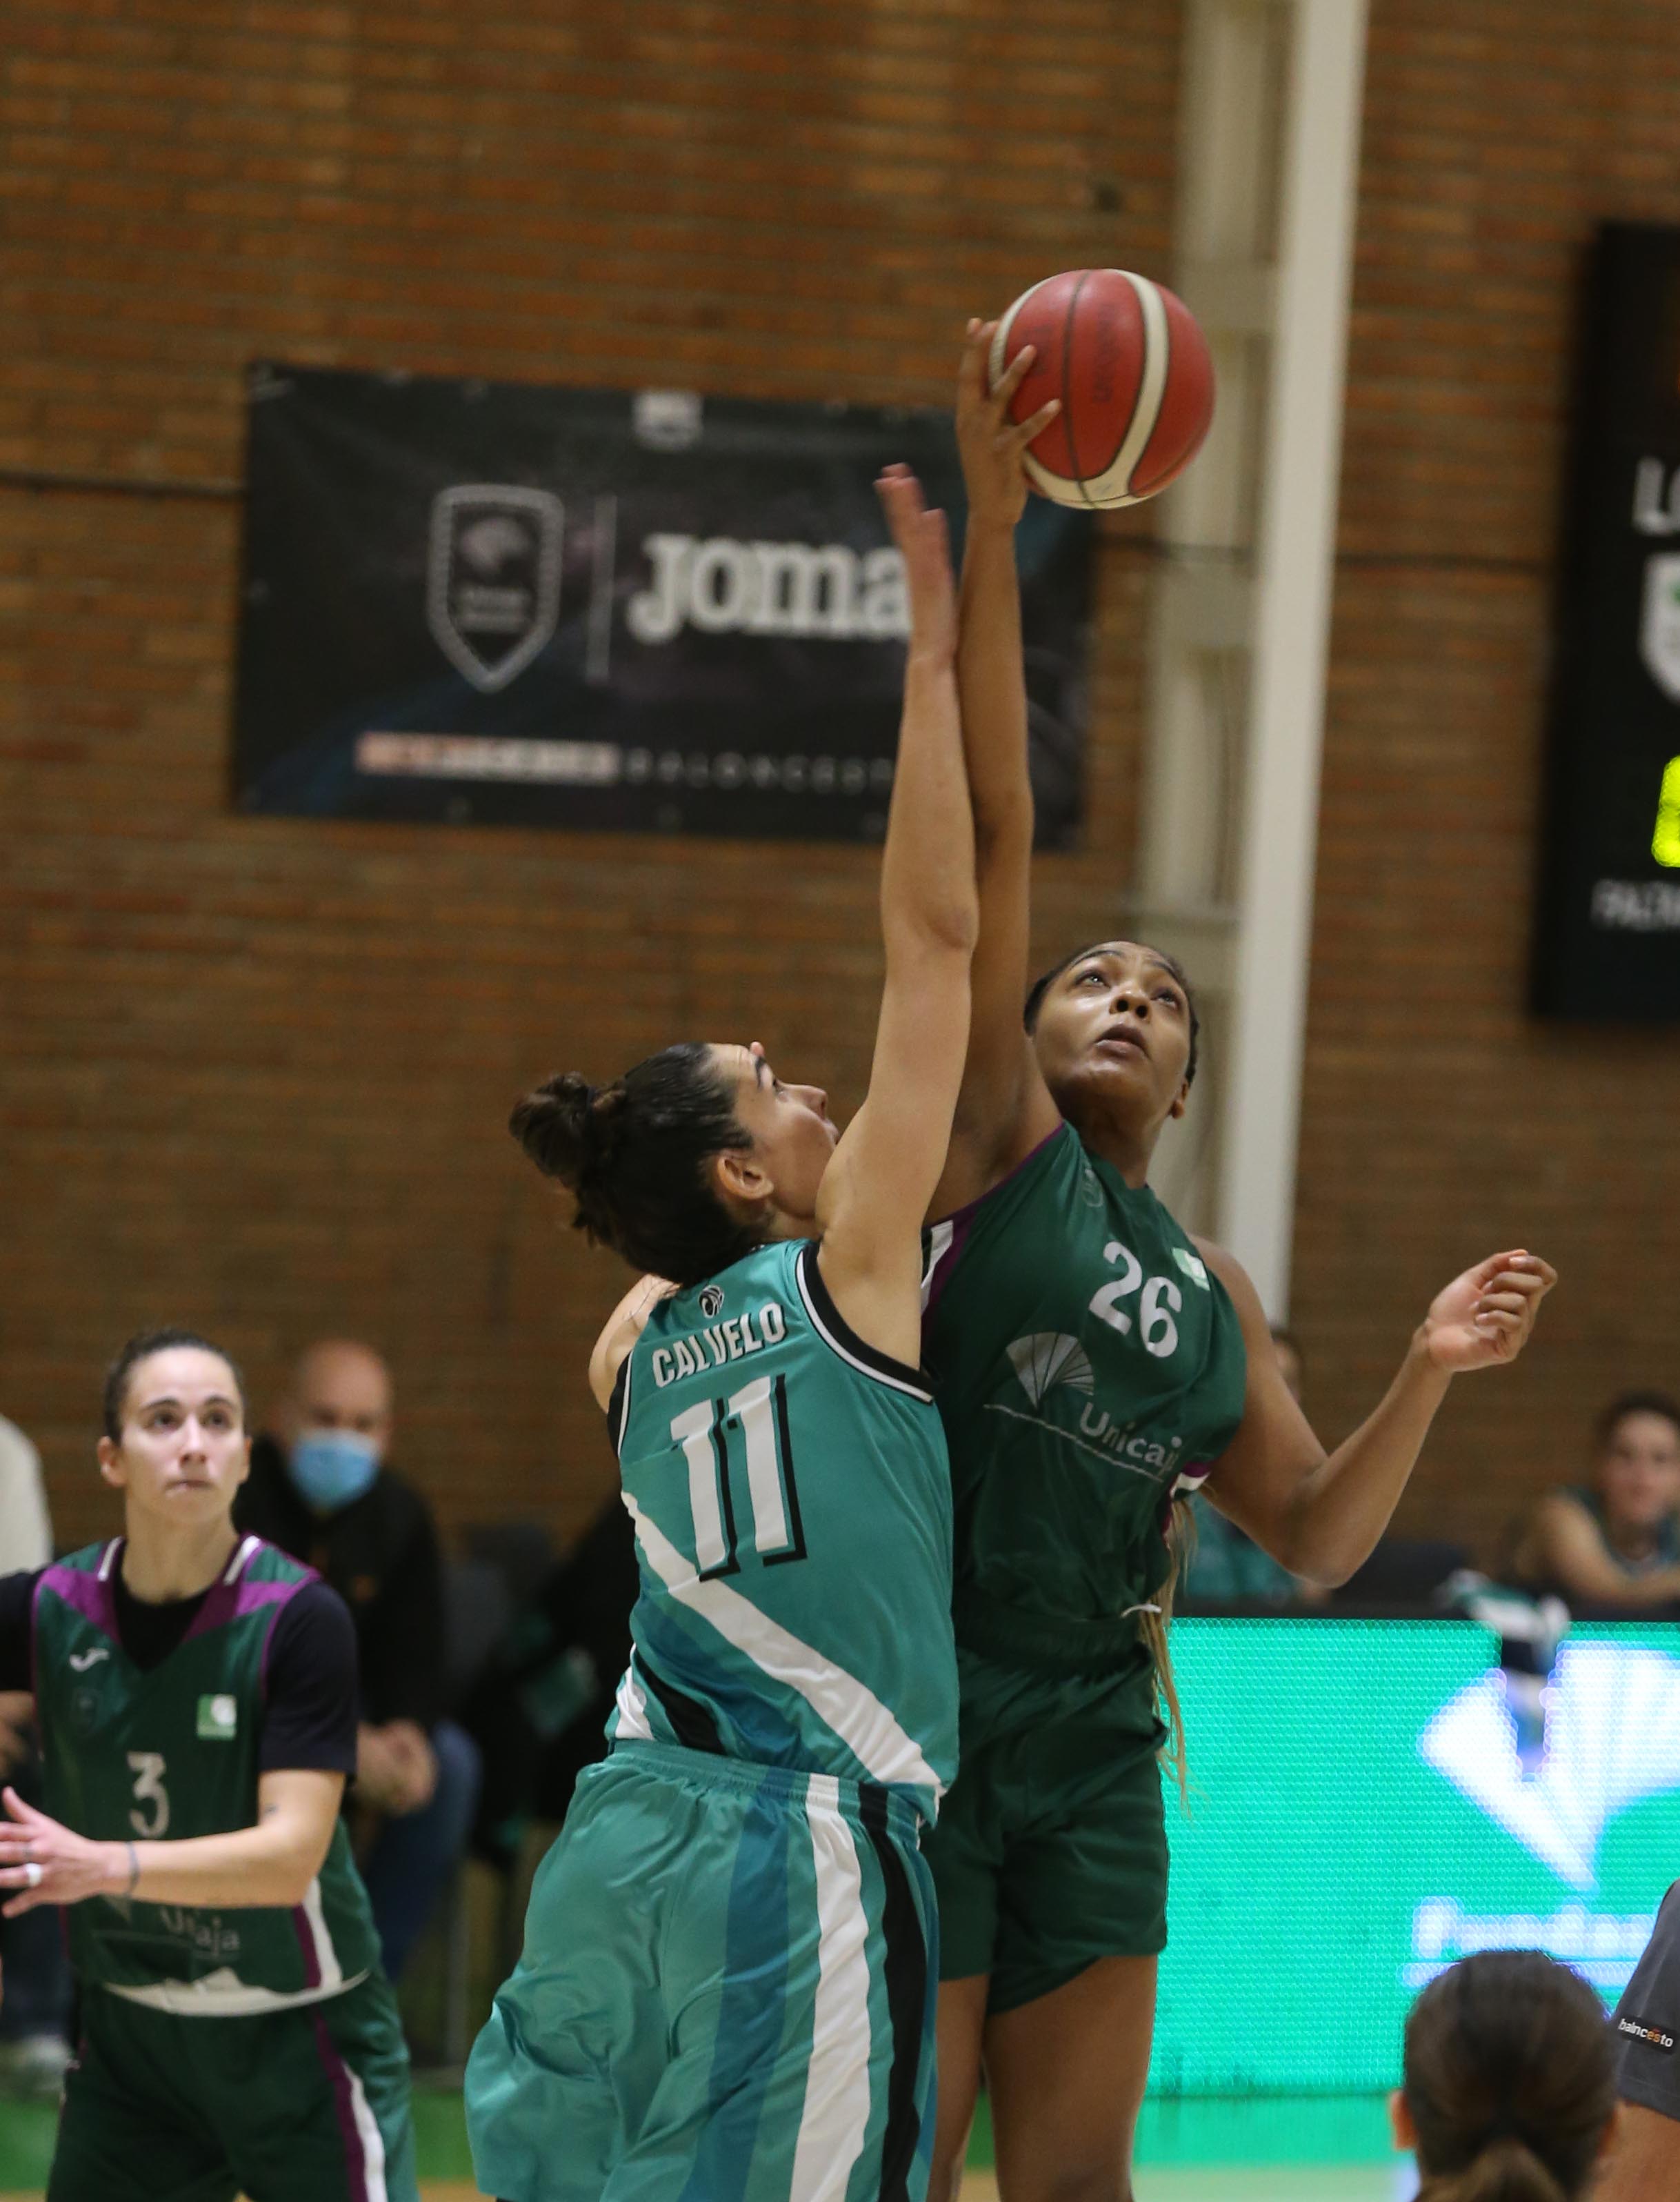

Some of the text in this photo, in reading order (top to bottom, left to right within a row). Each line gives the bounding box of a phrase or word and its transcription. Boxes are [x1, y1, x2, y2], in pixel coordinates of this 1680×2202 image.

[1088, 1241, 1182, 1358] 26
[652, 1302, 789, 1388] CALVELO
[670, 1374, 807, 1581] 11
[1080, 1402, 1182, 1477] Unicaj
[127, 1752, 170, 1838] 3
